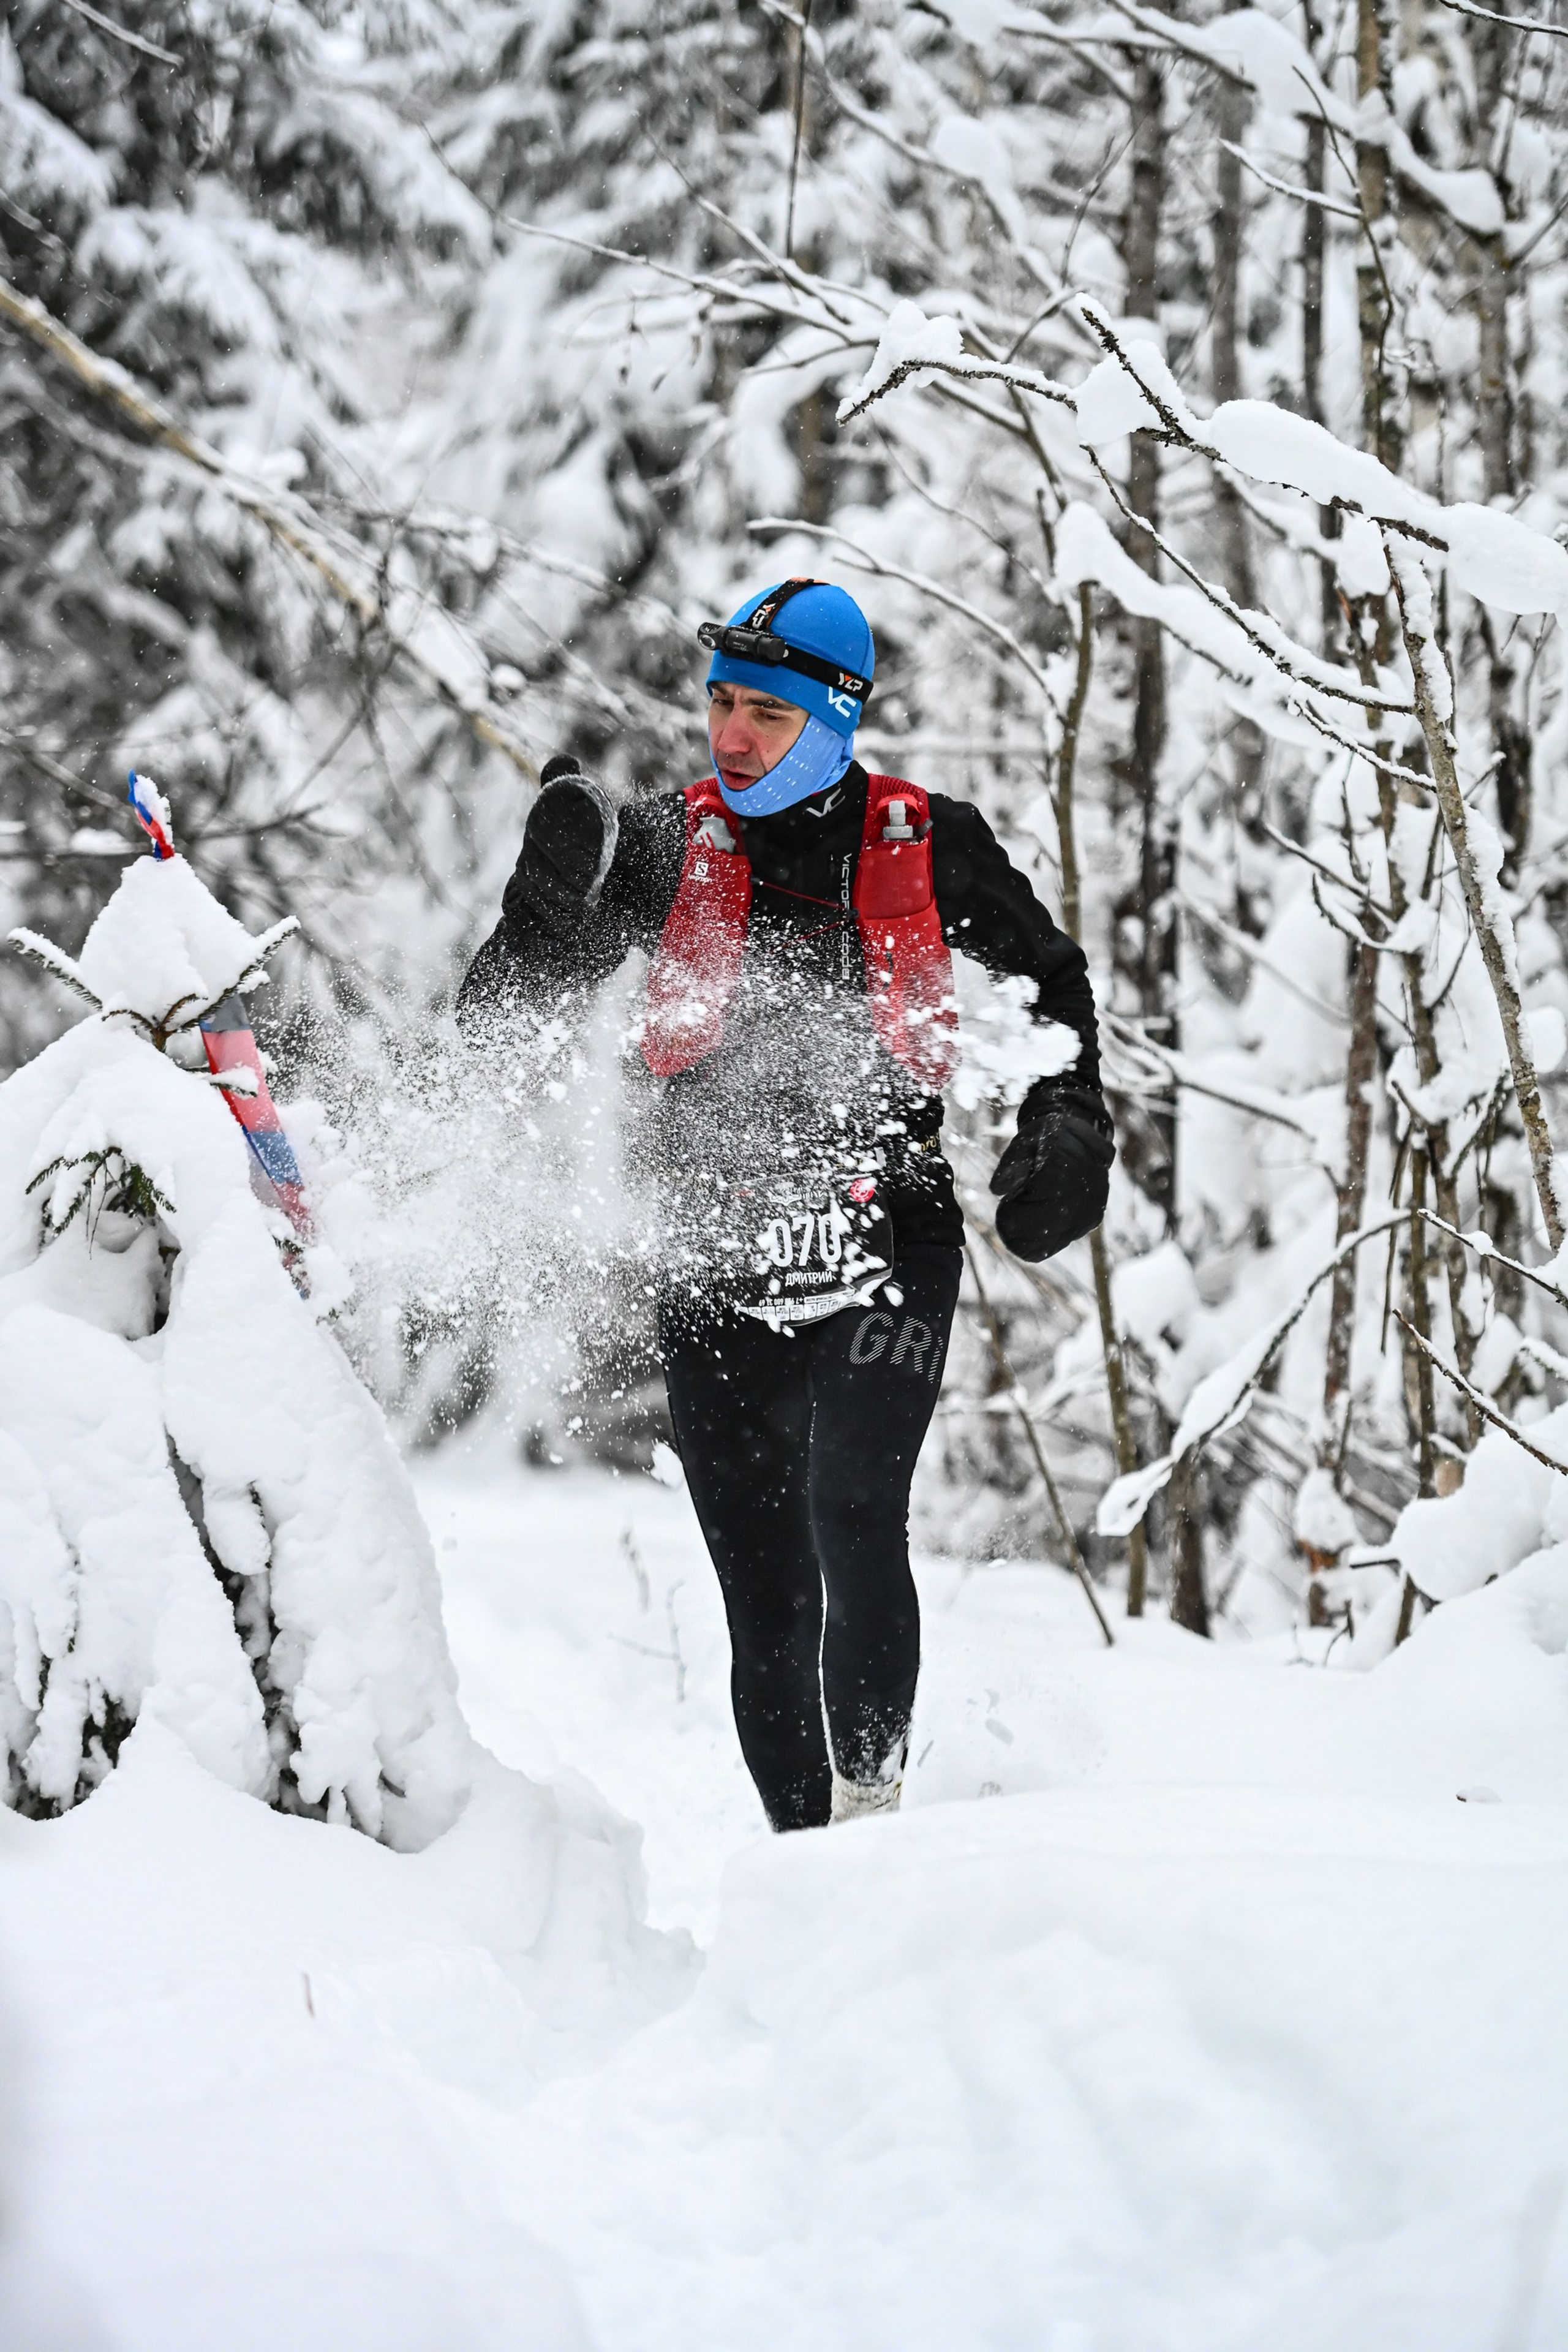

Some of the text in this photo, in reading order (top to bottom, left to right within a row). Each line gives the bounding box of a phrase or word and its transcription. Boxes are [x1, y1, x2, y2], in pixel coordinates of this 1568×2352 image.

[828, 686, 857, 718] VC
[806, 788, 845, 818] VC
[841, 853, 853, 918] VICTOR
[768, 1213, 842, 1267] 070
[785, 1268, 833, 1287] ДМИТРИЙ
